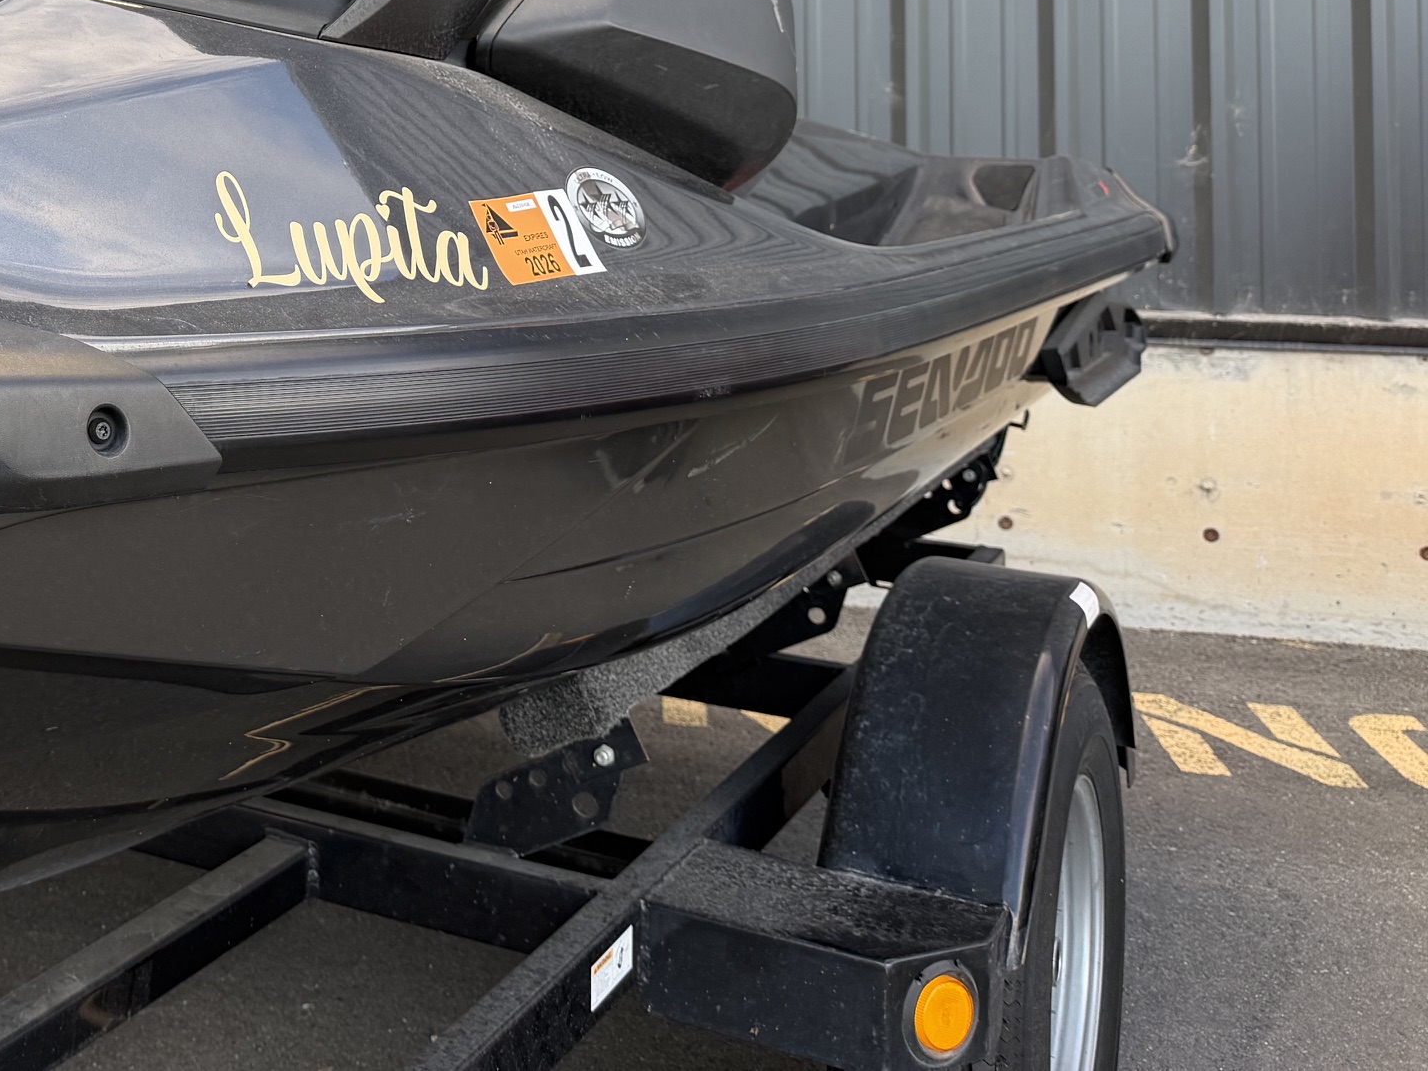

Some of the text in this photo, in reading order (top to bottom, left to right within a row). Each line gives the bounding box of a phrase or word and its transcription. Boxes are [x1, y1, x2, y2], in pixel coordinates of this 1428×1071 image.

[214, 170, 489, 304] Lupita
[523, 231, 549, 242] EXPIRES
[548, 194, 593, 268] 2
[603, 231, 643, 248] EMISSION
[529, 243, 556, 254] WATERCRAFT
[525, 252, 561, 277] 2026
